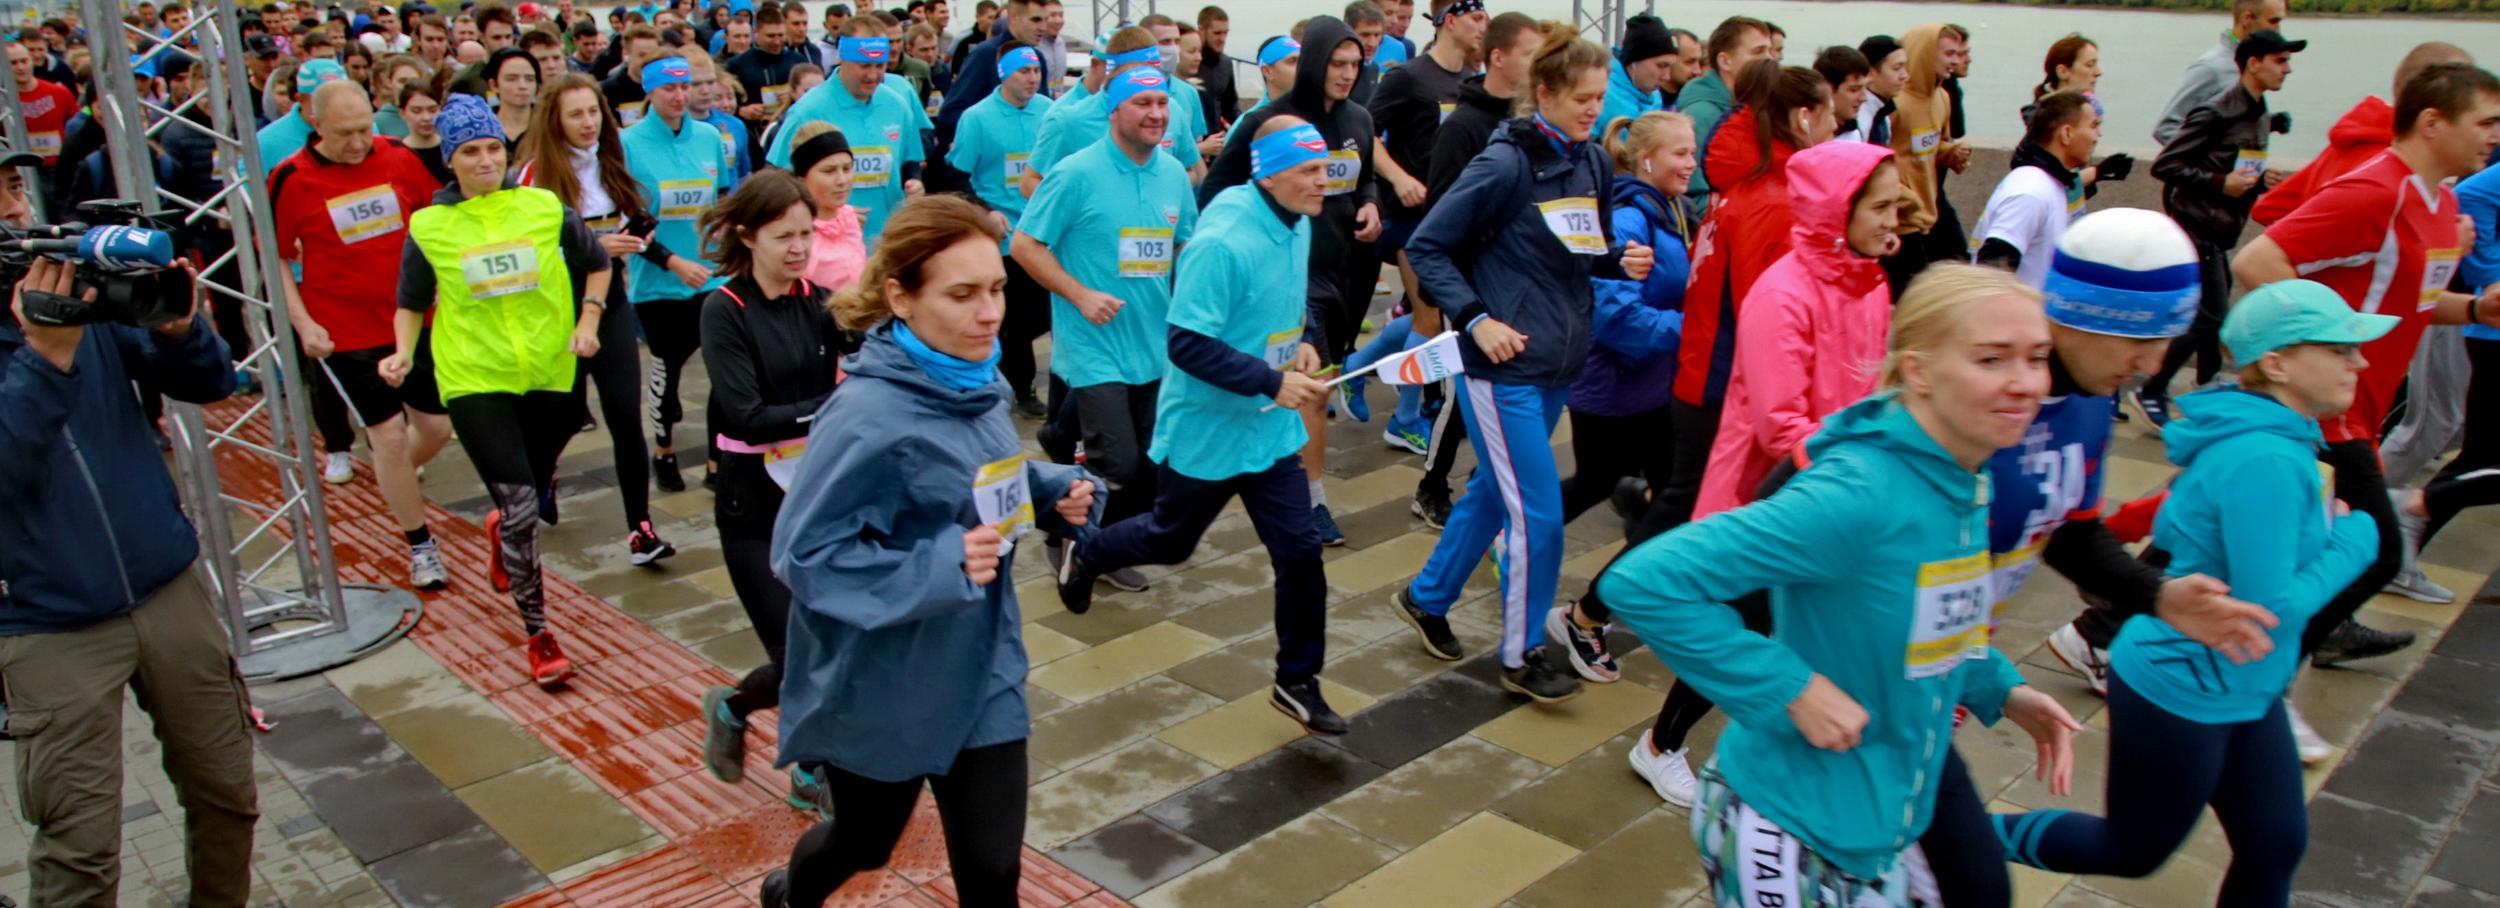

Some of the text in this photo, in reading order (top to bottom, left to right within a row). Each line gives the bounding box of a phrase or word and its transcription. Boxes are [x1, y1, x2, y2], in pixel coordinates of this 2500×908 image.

[853, 157, 882, 173] 102
[673, 190, 703, 206] 107
[346, 199, 385, 222] 156
[1561, 212, 1592, 232] 175
[1135, 241, 1164, 259] 103
[481, 253, 520, 276] 151
